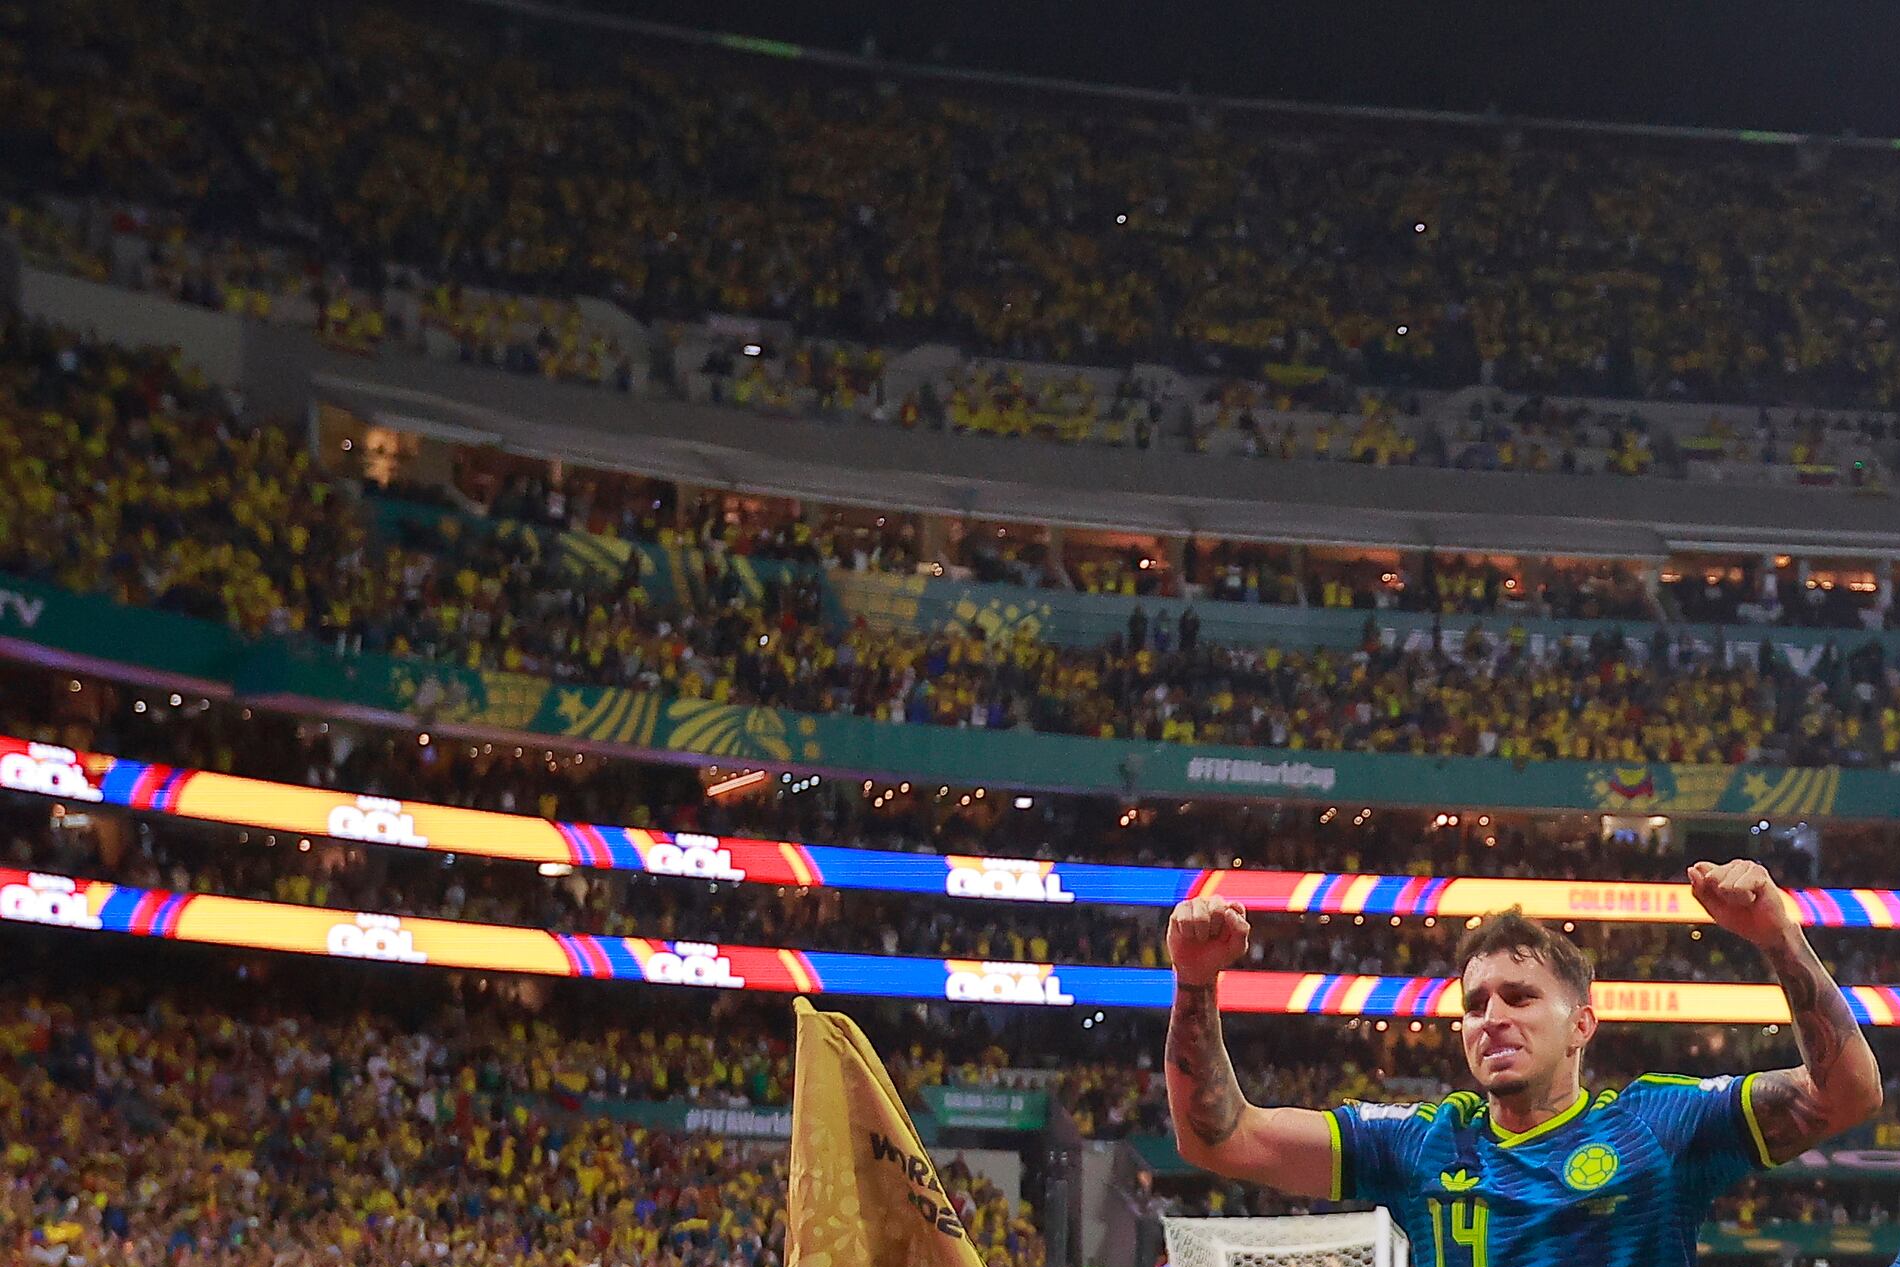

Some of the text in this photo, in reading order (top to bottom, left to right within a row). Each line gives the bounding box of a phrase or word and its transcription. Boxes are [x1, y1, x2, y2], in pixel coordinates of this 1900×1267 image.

[328, 805, 429, 848] GOL
[646, 843, 746, 881] GOL
[945, 867, 1076, 903] GOAL
[1568, 889, 1680, 913] COLOMBIA
[327, 924, 428, 964] GOL
[645, 952, 746, 989] GOL
[944, 971, 1075, 1006] GOAL
[1594, 988, 1680, 1012] LOMBIA
